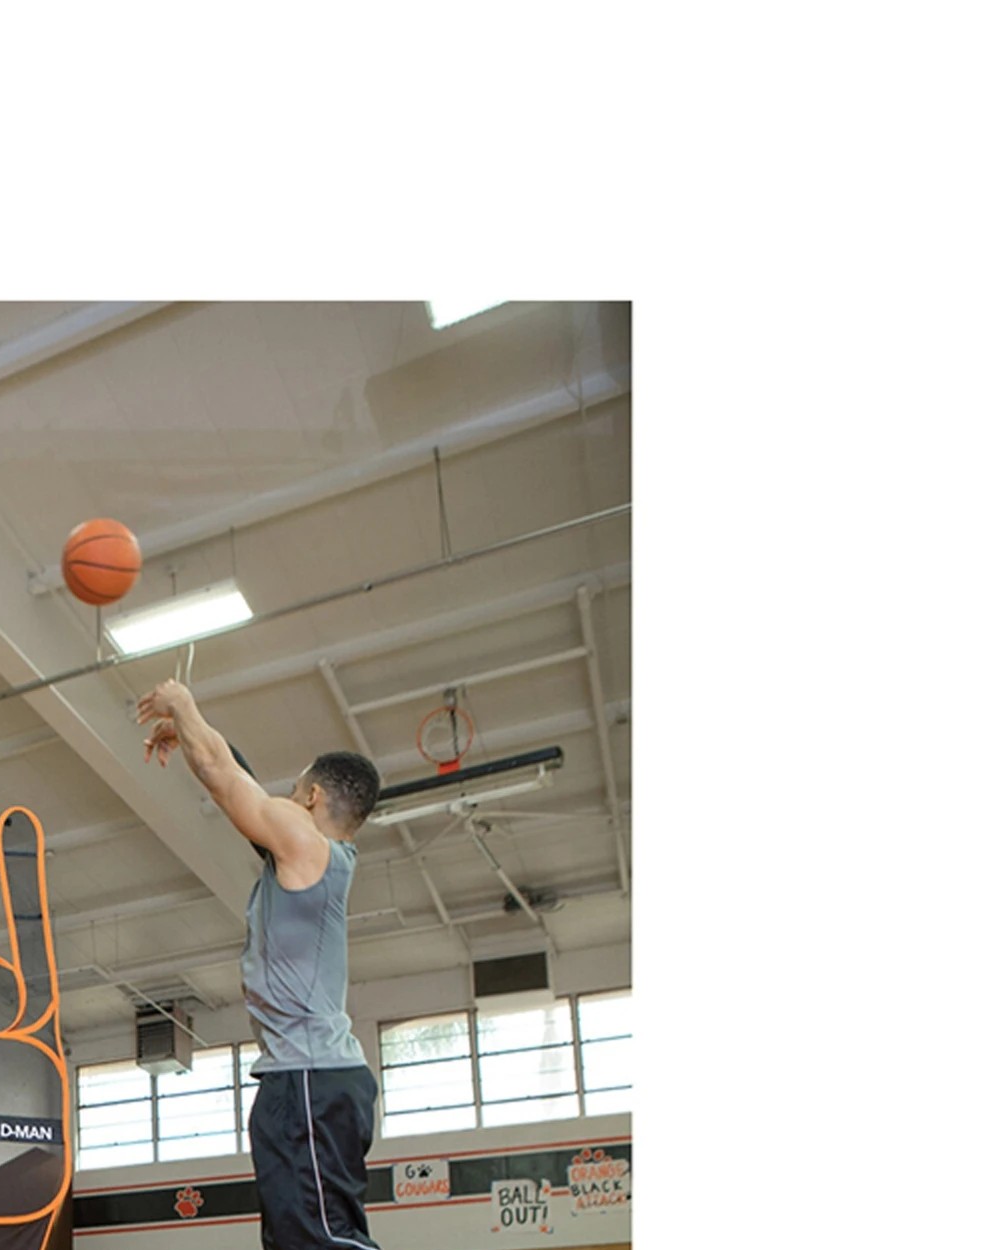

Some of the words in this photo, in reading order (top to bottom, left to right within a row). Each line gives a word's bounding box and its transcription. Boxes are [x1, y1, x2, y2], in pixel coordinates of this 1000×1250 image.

[0, 1122, 53, 1141] D-MAN
[396, 1179, 449, 1198] COUGARS
[499, 1185, 546, 1207] BALL
[571, 1180, 622, 1197] BLACK
[500, 1205, 548, 1227] OUT!
